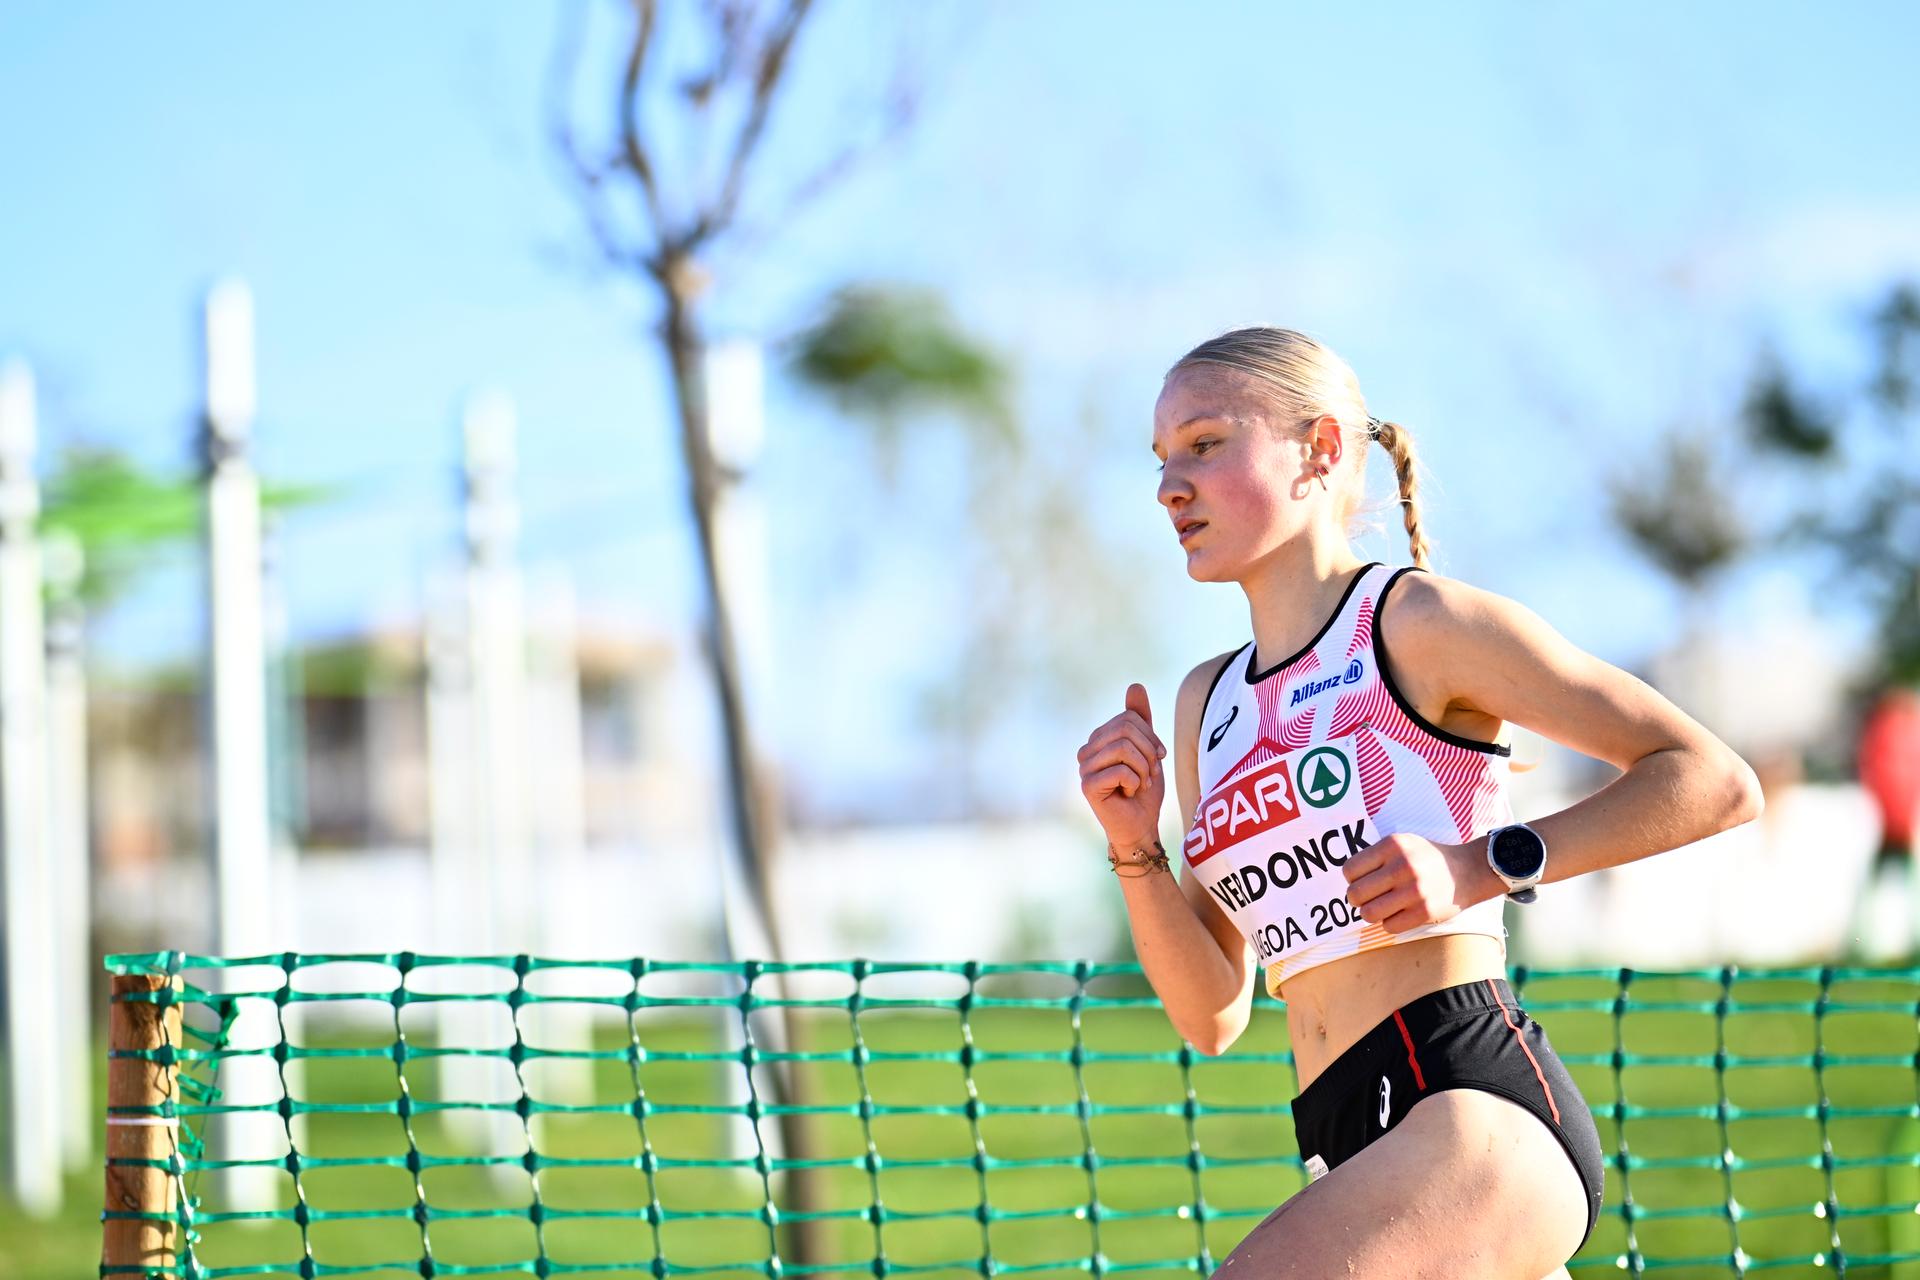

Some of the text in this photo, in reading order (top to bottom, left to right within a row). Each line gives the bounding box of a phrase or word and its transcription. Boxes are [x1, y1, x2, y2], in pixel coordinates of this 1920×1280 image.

[1290, 675, 1342, 707] Allianz
[1186, 772, 1293, 857] SPAR
[1209, 818, 1372, 912] VERDONCK
[1310, 894, 1363, 937] 20
